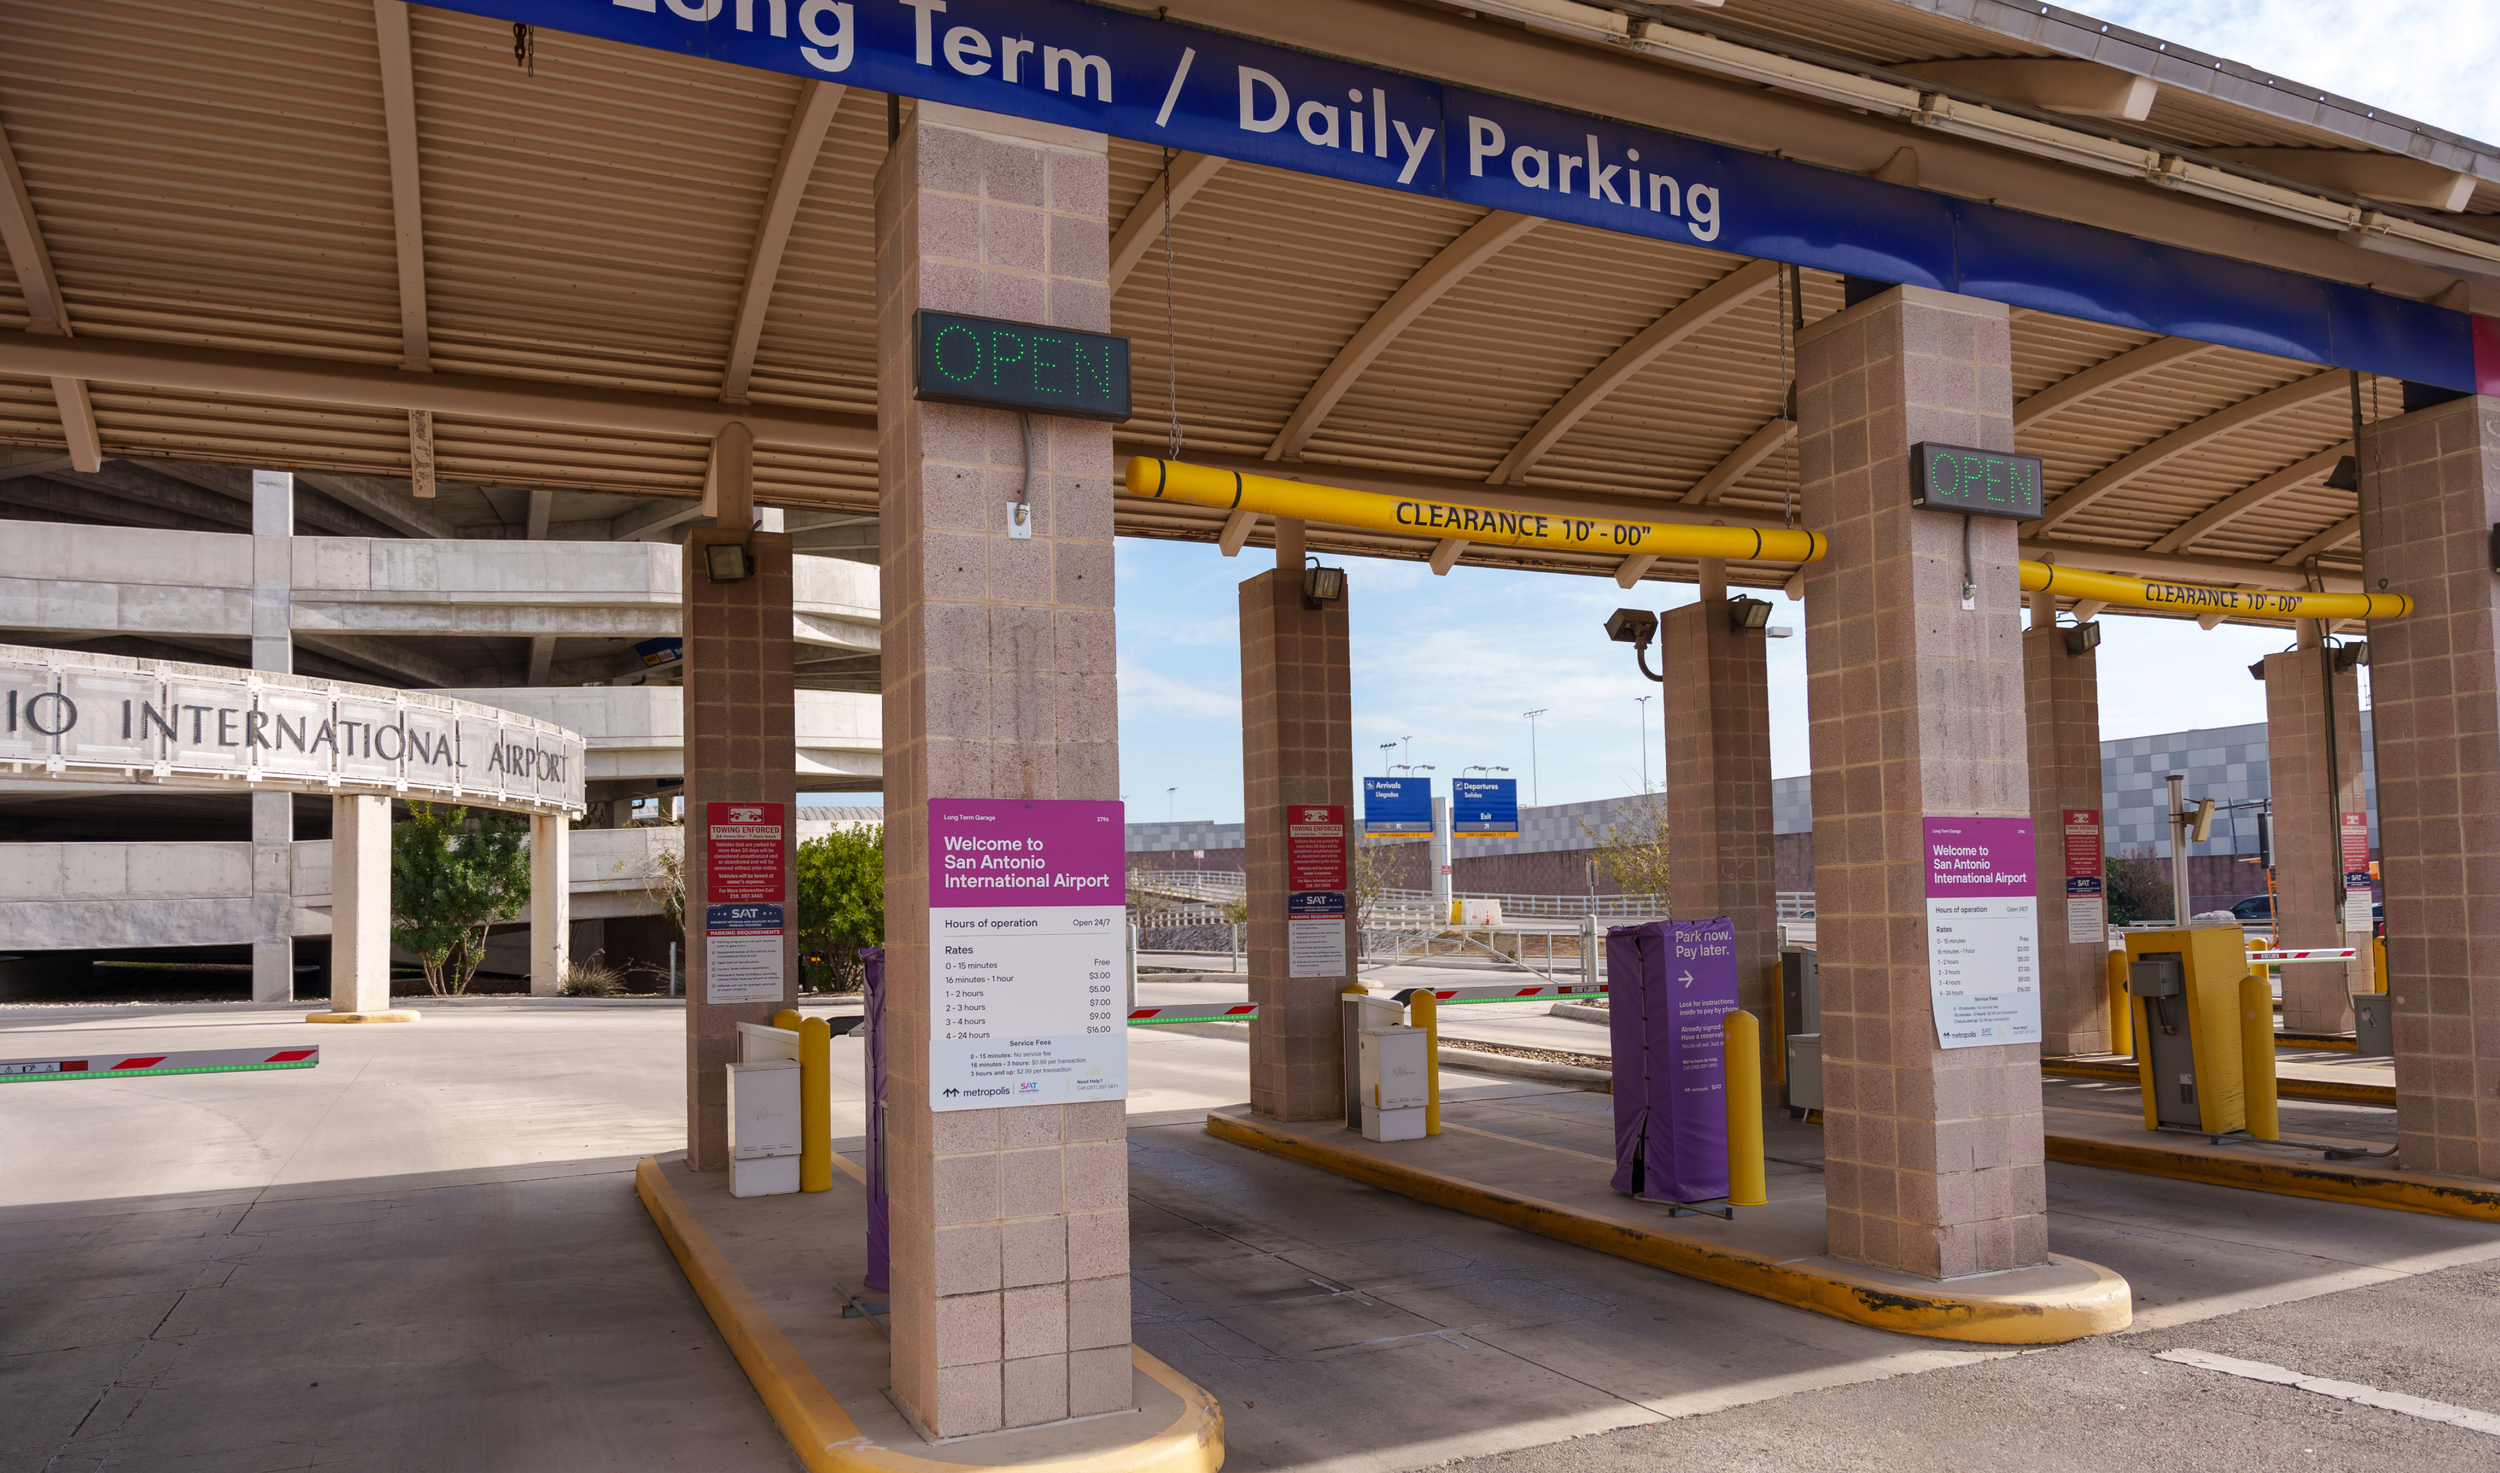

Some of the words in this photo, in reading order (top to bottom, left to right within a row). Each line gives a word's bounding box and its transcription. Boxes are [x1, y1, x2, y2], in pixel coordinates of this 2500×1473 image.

[612, 0, 855, 73] ng
[908, 0, 1112, 103] Term
[1155, 46, 1196, 129] /
[1238, 65, 1435, 184] Daily
[1468, 115, 1720, 242] Parking
[935, 325, 1109, 399] OPEN
[1932, 453, 2031, 505] OPEN
[1395, 501, 1549, 539] CLEARANCE
[2145, 583, 2239, 609] CLEARANCE
[9, 690, 78, 735] IO
[122, 699, 467, 768] INTERNATIONAL
[488, 741, 569, 784] AIRPORT
[1375, 781, 1401, 790] Arrivals
[1464, 782, 1499, 791] Departures
[1375, 791, 1399, 799] Llegadas
[944, 814, 959, 822] Long
[1480, 812, 1491, 820] Exit
[711, 826, 740, 834] TOWING
[742, 826, 780, 834] ENFORCED
[944, 836, 1023, 851] Welcome
[1027, 837, 1043, 851] to
[1932, 845, 1977, 856] Welcome
[1978, 845, 1989, 856] to
[944, 854, 976, 869] San
[980, 854, 1046, 869] Antonio
[1933, 858, 1952, 870] San
[1953, 858, 1991, 870] Antonio
[945, 873, 1049, 888] International
[1053, 873, 1110, 891] Airport
[1934, 872, 1993, 884] International
[1995, 872, 2027, 886] Airport
[2077, 879, 2090, 887] SAT
[1306, 896, 1326, 905] SAT
[731, 908, 759, 918] SAT
[1935, 906, 1952, 914] Hours
[1953, 906, 1960, 914] of
[1960, 906, 1988, 914] operation
[945, 919, 975, 928] Hours
[978, 918, 988, 928] of
[990, 918, 1038, 930] operation
[1072, 919, 1093, 927] Open
[1094, 918, 1110, 927] 24/7
[1675, 930, 1702, 943] Park
[1704, 931, 1732, 942] now.
[945, 946, 974, 955] Rates
[1676, 945, 1698, 960] Pay
[1700, 944, 1730, 957] later.
[945, 962, 951, 970] 0
[958, 962, 966, 970] 15
[968, 961, 998, 970] minutes
[1094, 958, 1110, 966] Free
[945, 976, 953, 984] 16
[955, 975, 985, 984] minutes
[996, 975, 1014, 983] hour
[1089, 972, 1110, 980] $3.00
[1089, 985, 1110, 993] $5.00
[955, 990, 961, 998] 2
[1089, 999, 1111, 1007] $7.00
[1701, 998, 1735, 1006] instructions
[945, 1004, 951, 1012] 2
[957, 1004, 963, 1012] 3
[1679, 1008, 1696, 1016] inside
[1703, 1008, 1714, 1016] pay
[1714, 1007, 1721, 1015] by
[1089, 1012, 1111, 1020] $9.00
[945, 1018, 951, 1026] 3
[964, 1017, 986, 1025] hours
[1086, 1025, 1111, 1034] $16.00
[1681, 1025, 1702, 1033] Already
[1702, 1024, 1721, 1032] signed
[945, 1032, 951, 1040] 4
[968, 1031, 990, 1039] hours
[1951, 1031, 1977, 1039] metropolis
[1005, 1069, 1016, 1077] up:
[1042, 1066, 1072, 1074] transaction
[963, 1086, 1011, 1098] metropolis
